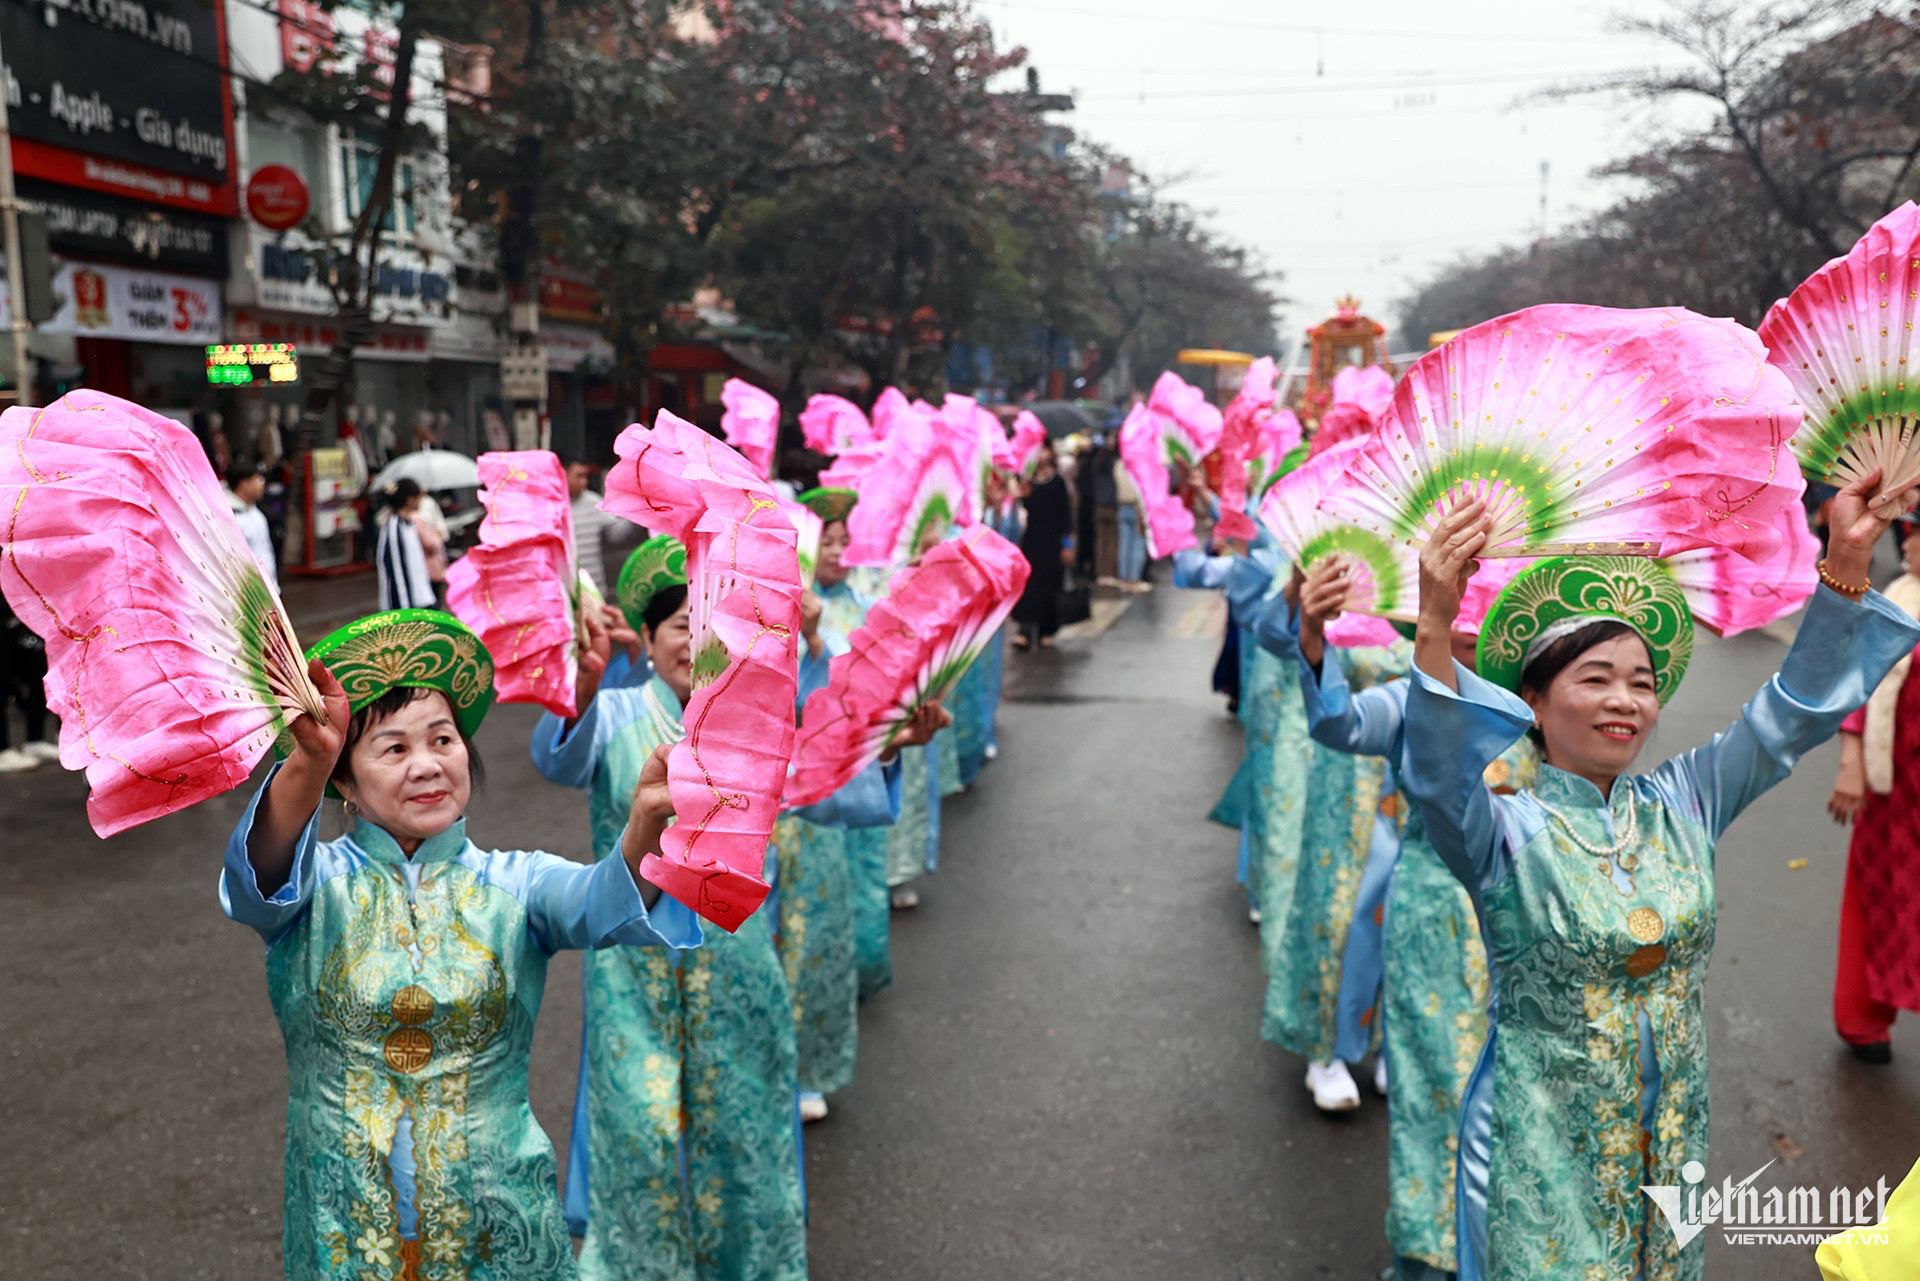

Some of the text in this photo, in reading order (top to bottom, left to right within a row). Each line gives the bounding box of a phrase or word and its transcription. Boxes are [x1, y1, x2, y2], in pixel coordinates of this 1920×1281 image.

[51, 80, 114, 136] Apple
[135, 106, 173, 148] Gia
[174, 117, 226, 171] dụng
